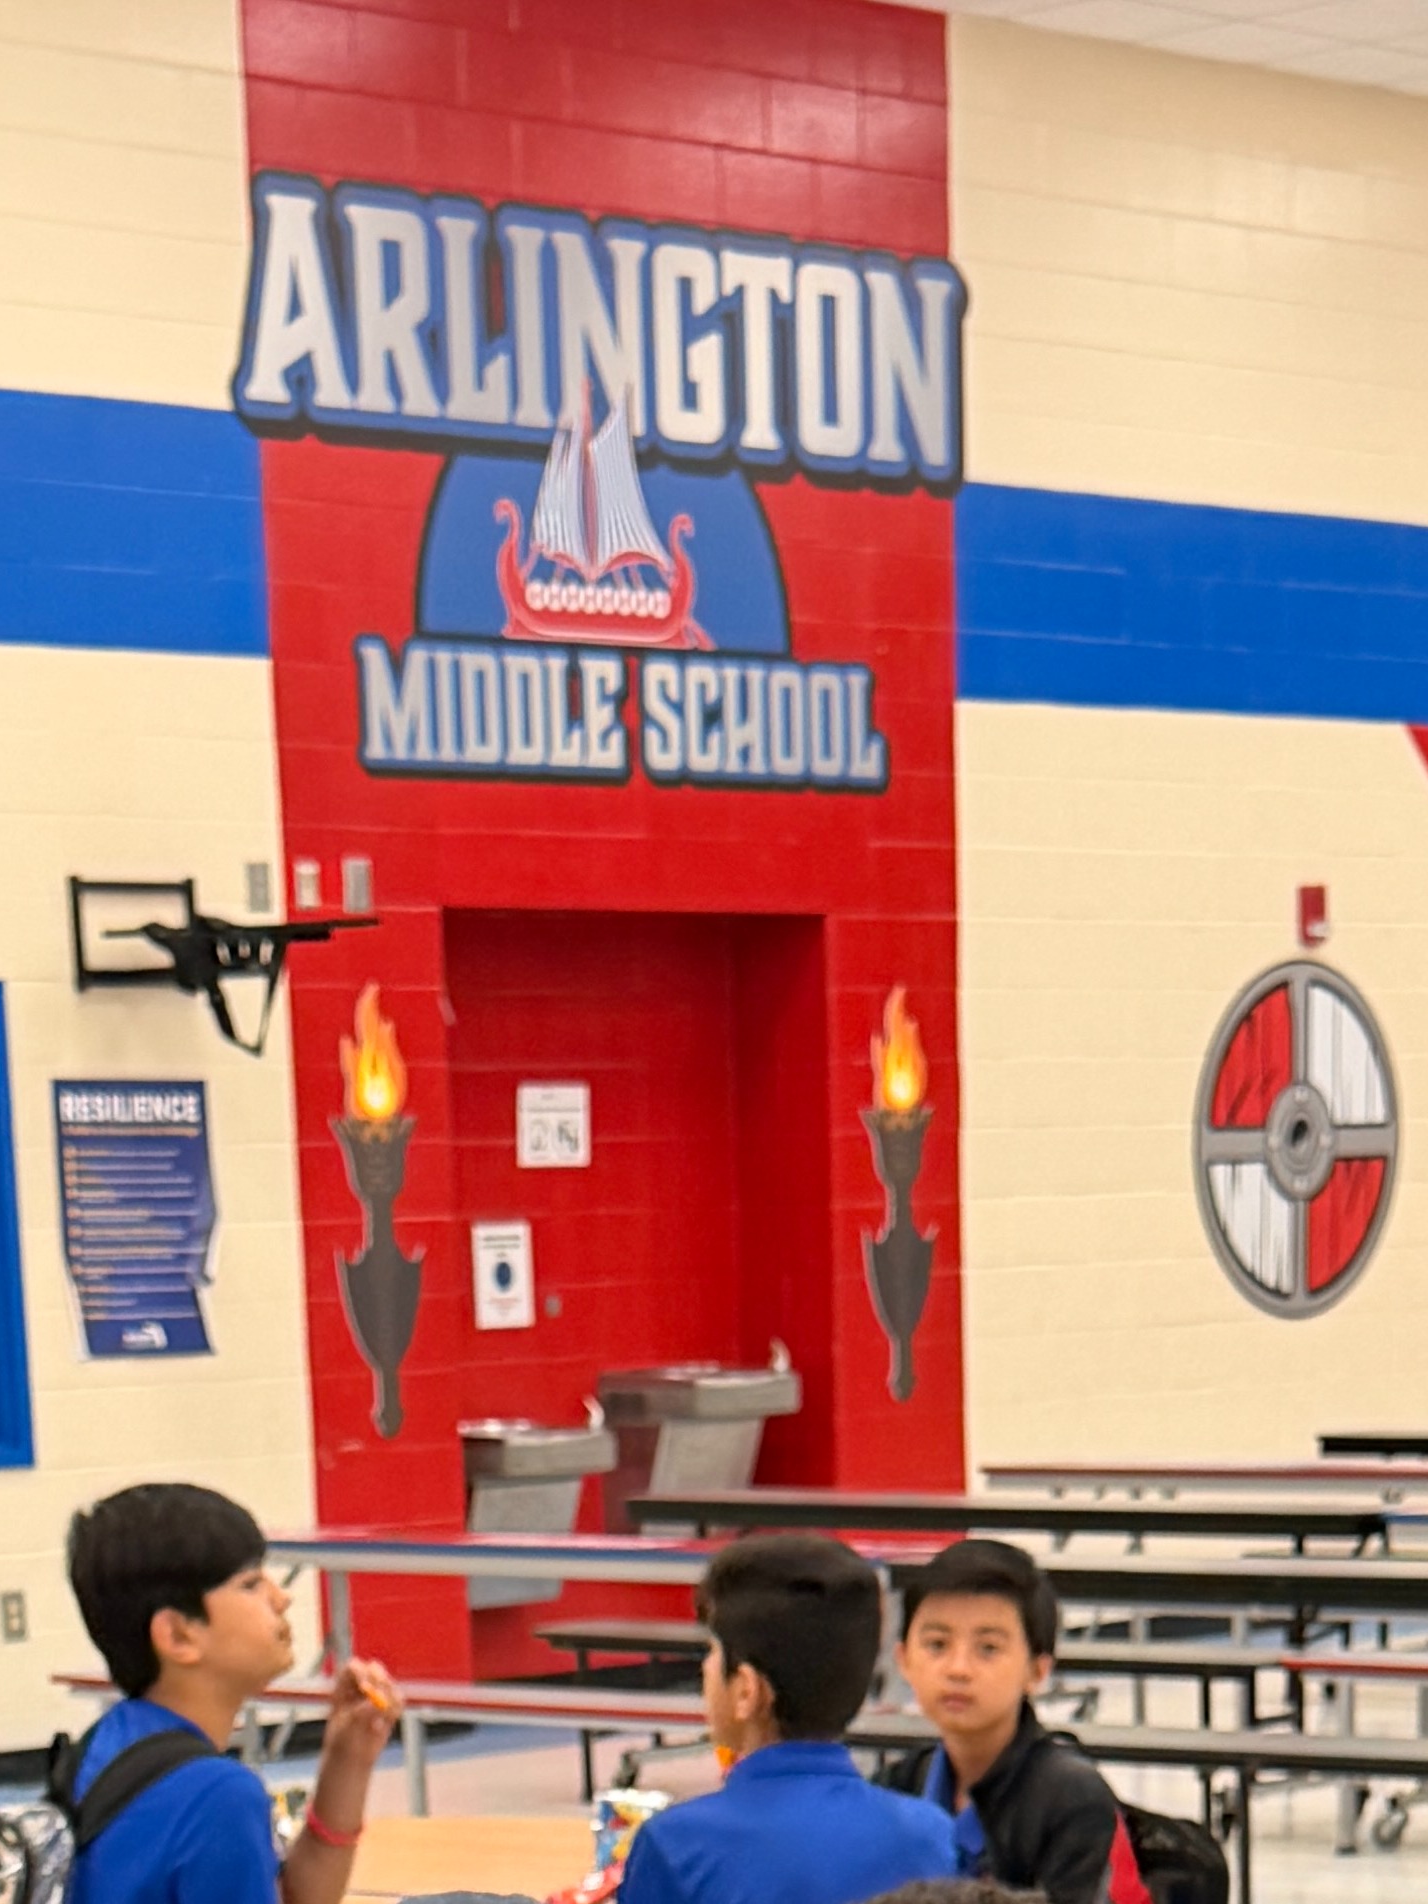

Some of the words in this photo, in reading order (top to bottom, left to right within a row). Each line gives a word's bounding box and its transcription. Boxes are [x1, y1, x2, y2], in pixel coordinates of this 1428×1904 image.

[239, 184, 958, 480] ARLINGTON
[359, 644, 627, 772] MIDDLE
[643, 656, 888, 781] SCHOOL
[58, 1090, 202, 1123] RESILIENCE
